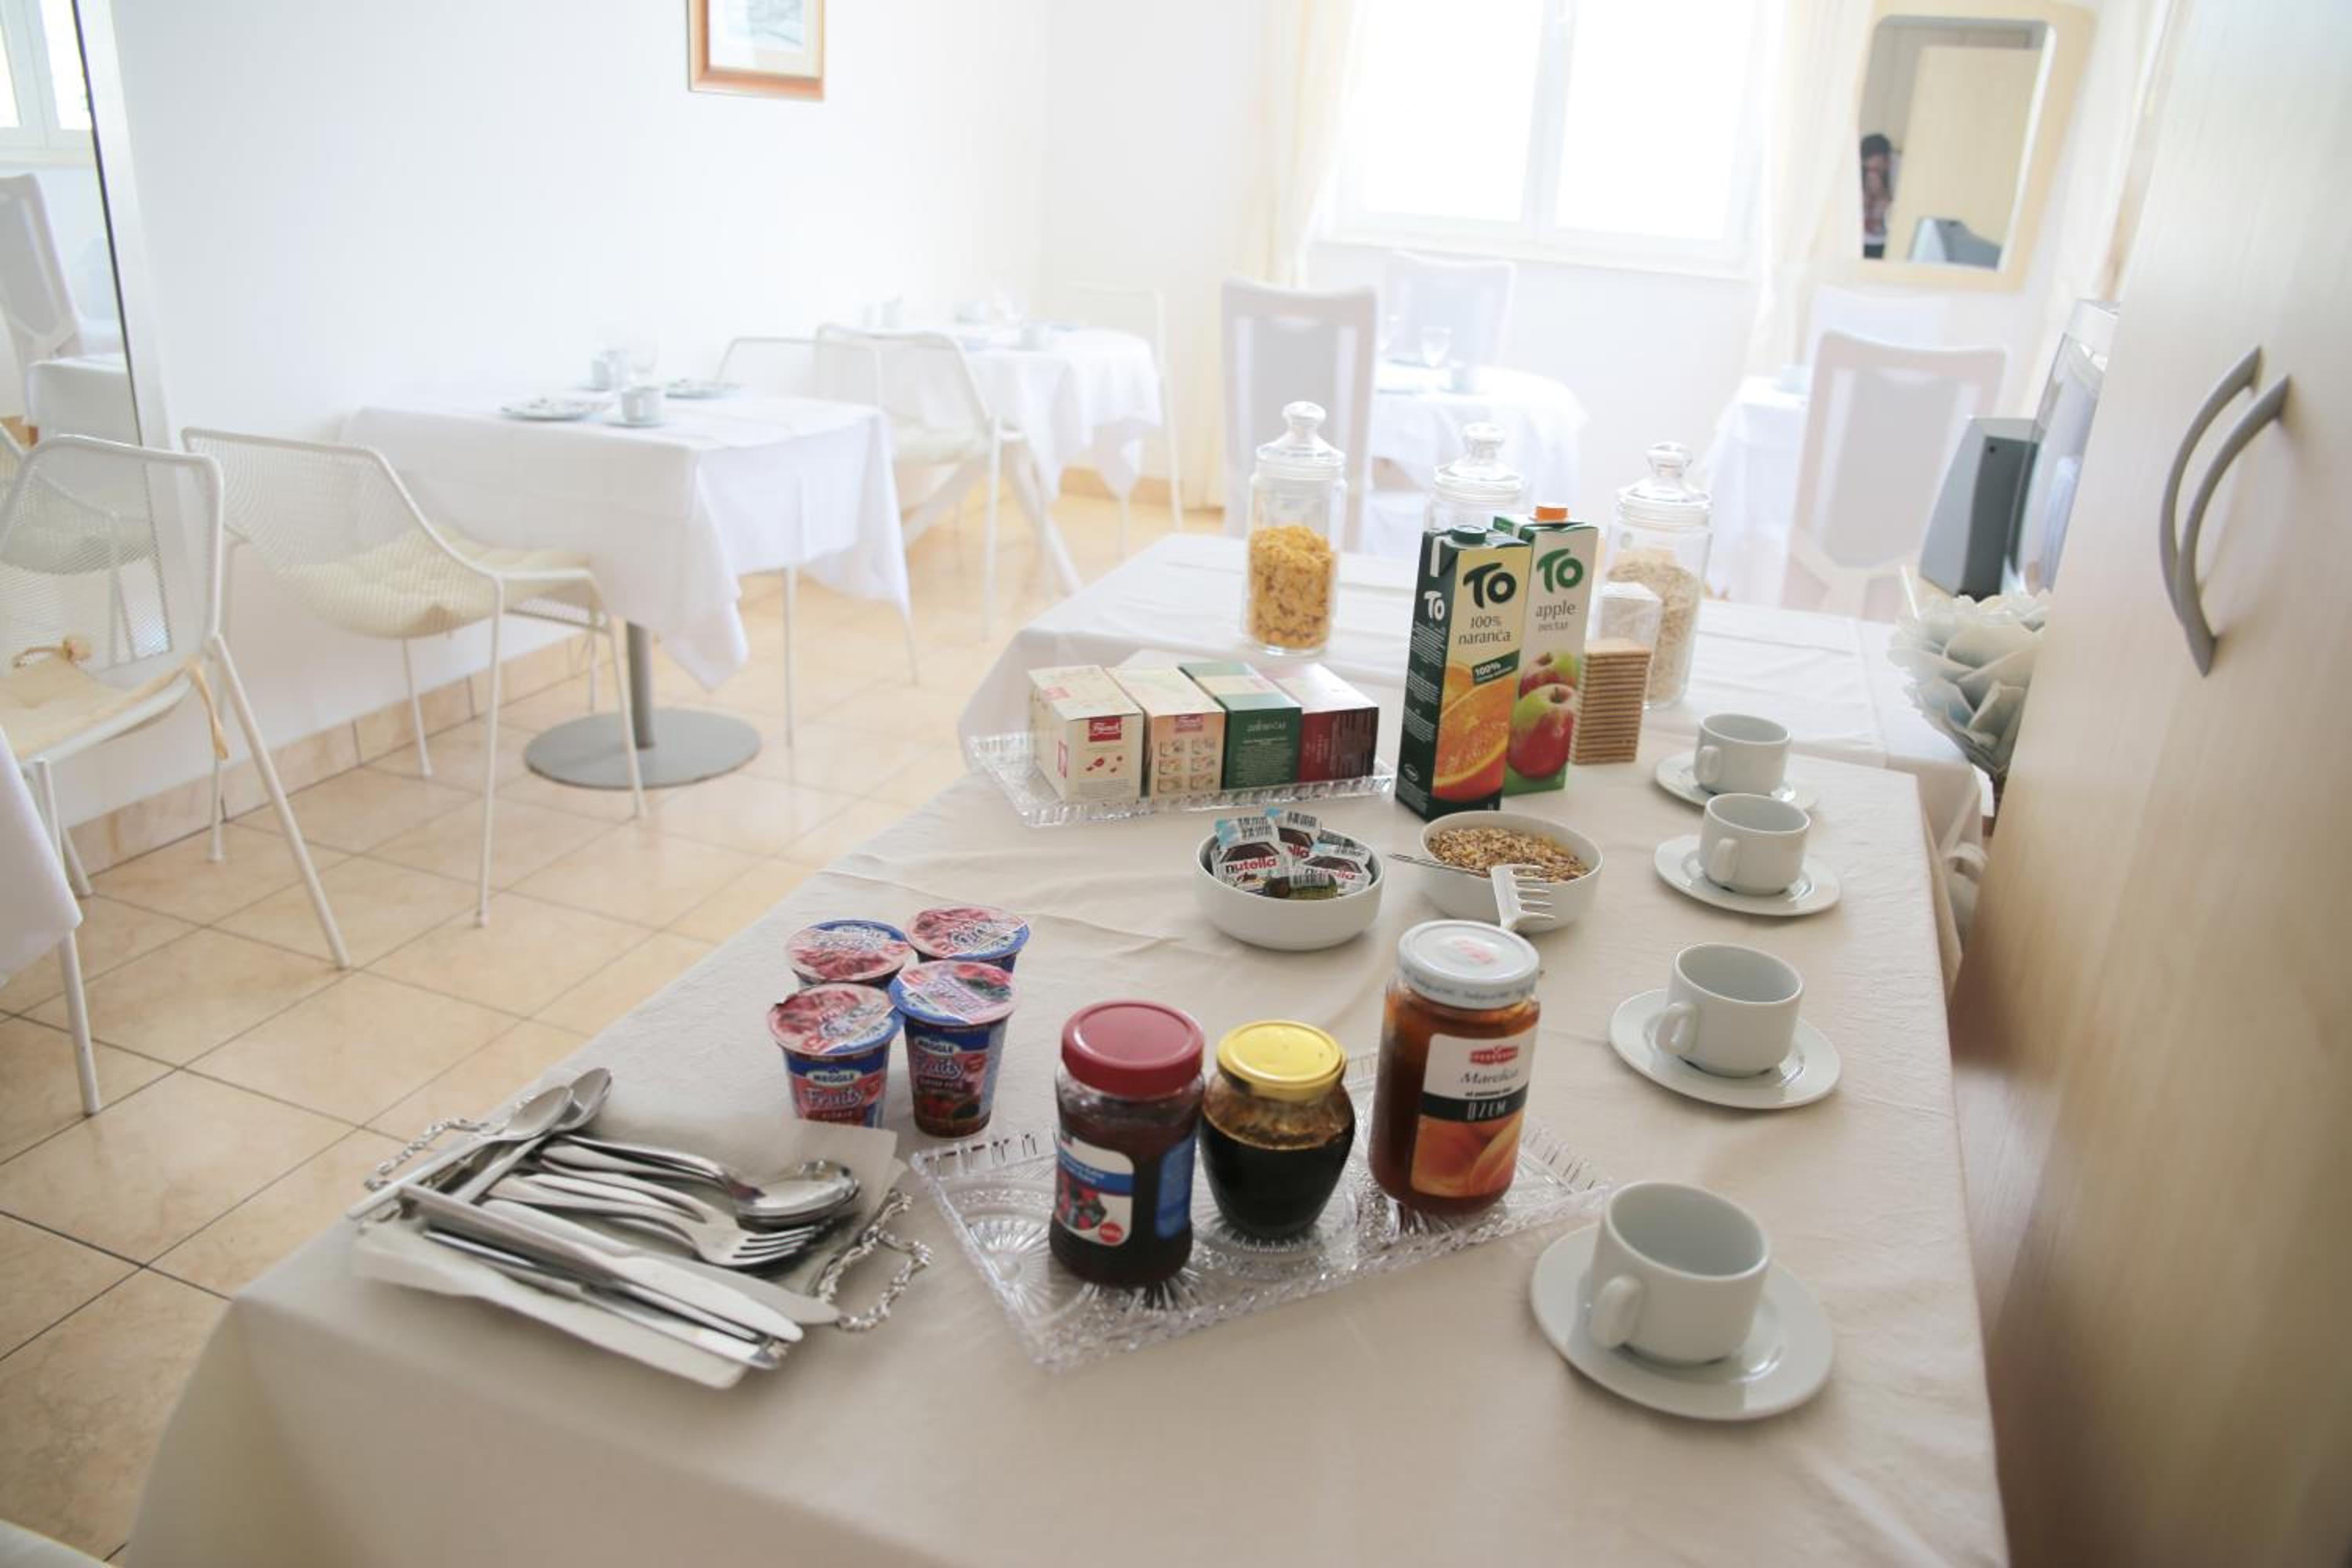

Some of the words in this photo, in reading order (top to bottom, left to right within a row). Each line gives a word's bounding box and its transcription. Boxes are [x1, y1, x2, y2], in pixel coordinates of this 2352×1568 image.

[1536, 600, 1577, 619] apple
[1470, 615, 1501, 629] 100%
[1538, 620, 1569, 632] nectar
[1225, 853, 1277, 873] nutella
